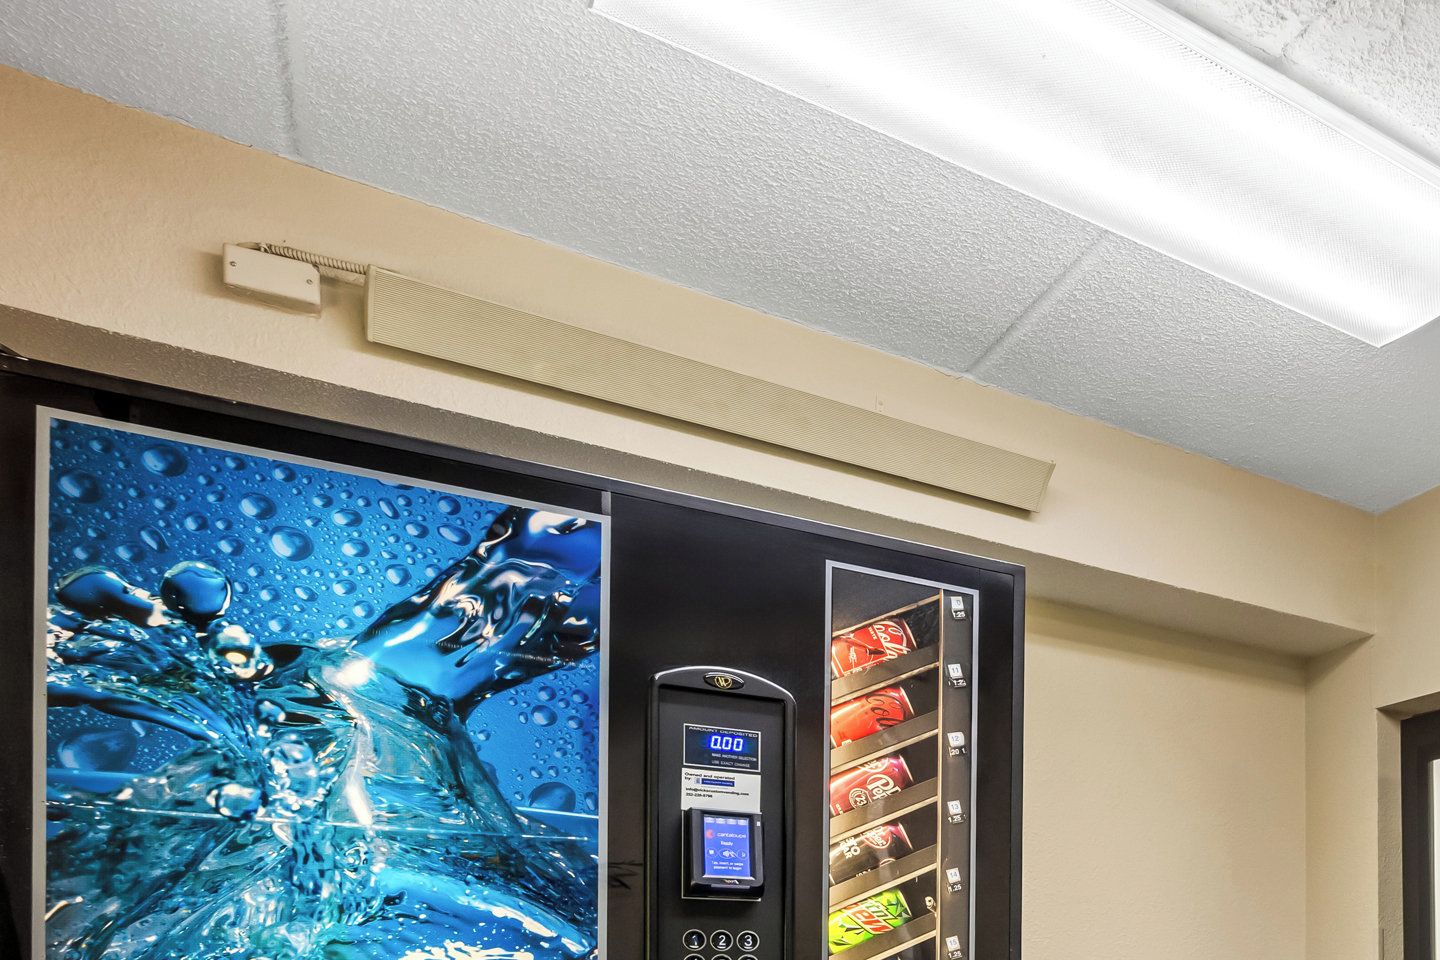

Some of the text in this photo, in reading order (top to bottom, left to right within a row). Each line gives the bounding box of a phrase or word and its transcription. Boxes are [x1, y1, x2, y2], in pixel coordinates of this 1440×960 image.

[719, 729, 758, 738] DEPOSITED
[710, 735, 744, 752] 0.00
[718, 934, 726, 946] 2
[744, 934, 753, 947] 3
